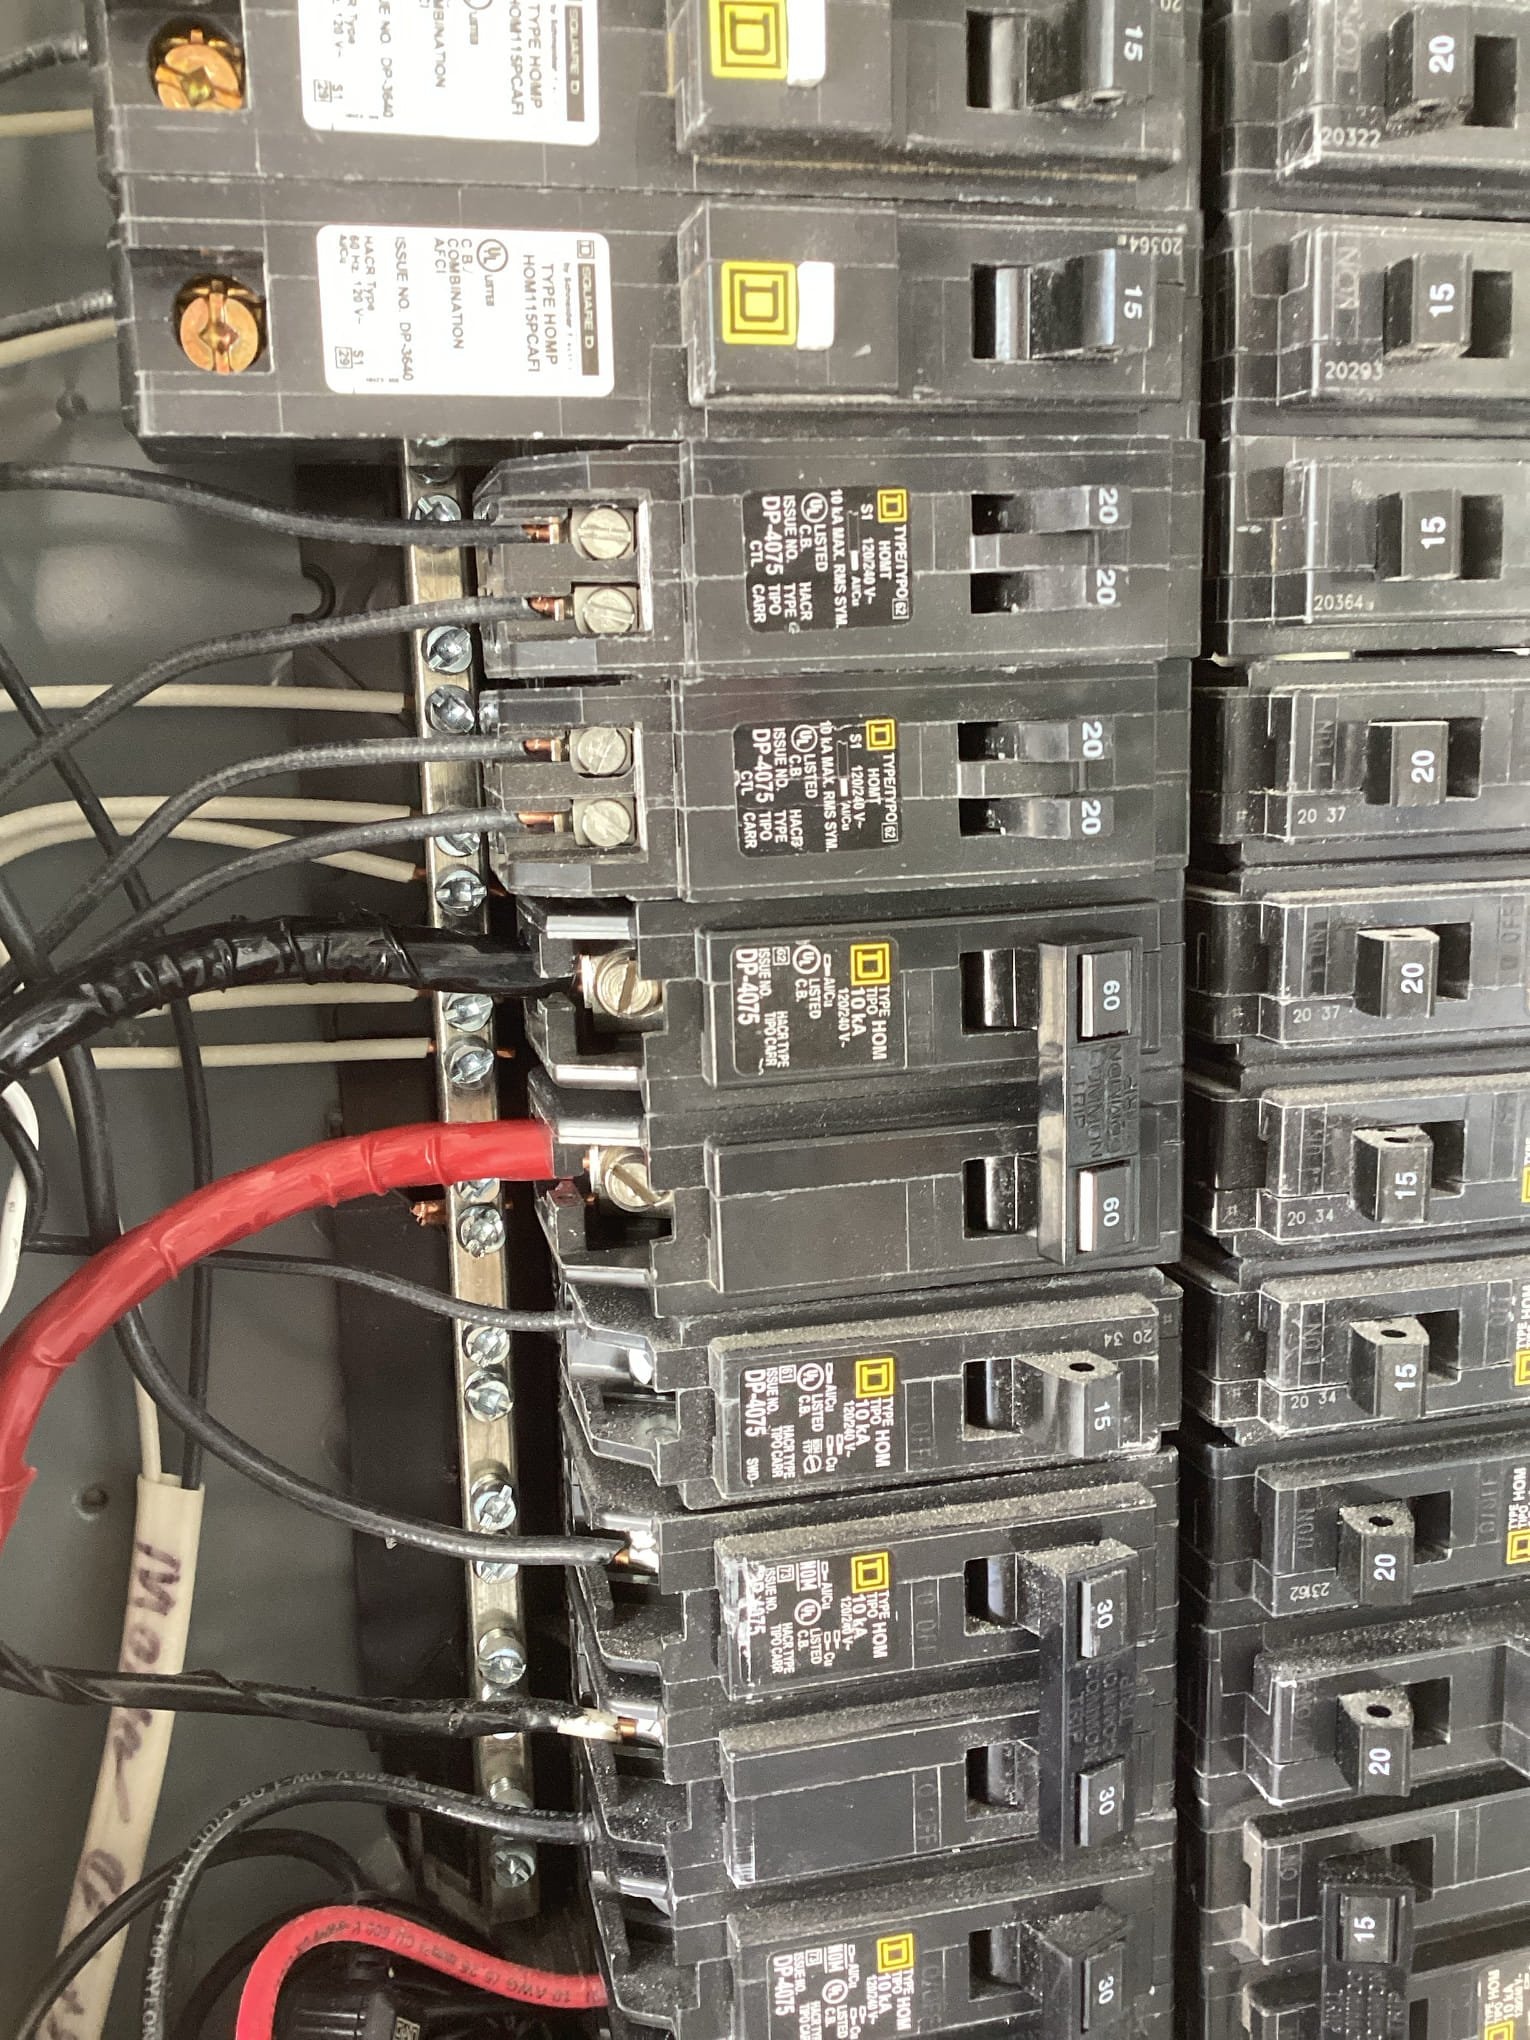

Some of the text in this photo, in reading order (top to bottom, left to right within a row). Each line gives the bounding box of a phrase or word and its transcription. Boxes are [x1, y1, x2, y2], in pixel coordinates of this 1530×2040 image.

[528, 4, 543, 109] TYPE HOMP
[1123, 25, 1143, 62] 15
[1429, 35, 1454, 73] 20
[1321, 126, 1381, 149] 20322
[350, 235, 363, 303] 60 120
[364, 236, 377, 311] HACR Type
[434, 238, 446, 274] AFCI
[395, 237, 414, 381] ISSUE DP-3640
[447, 238, 464, 349] COMBINATION
[582, 266, 594, 349] SQUARE D
[1123, 285, 1142, 319] 15
[1430, 283, 1454, 317] 15
[523, 255, 540, 372] HOM115PCAFI
[541, 264, 558, 365] TYPE HOMP
[339, 350, 349, 366] 29
[353, 350, 364, 365] S1
[1325, 360, 1383, 381] 20293
[1098, 487, 1118, 524] 20
[762, 496, 782, 575] DP-4075
[783, 495, 798, 563] ISSUE NO.
[799, 524, 812, 552] C.B.
[860, 503, 875, 585] S1 120/240
[1421, 517, 1445, 550] 15
[749, 540, 763, 568] CTL
[814, 524, 828, 572] LISTED
[830, 489, 847, 629] 10 kA MAX. RMS SYM.
[878, 540, 892, 580] HOMT
[752, 584, 766, 623] CARR
[768, 584, 781, 615] TIPO
[783, 583, 796, 618] TYPE
[799, 582, 812, 621] HACR
[1095, 569, 1116, 605] 20
[1313, 594, 1363, 611] 20364
[895, 602, 906, 615] 62
[1082, 720, 1102, 758] 20
[752, 728, 774, 803] DP-4075
[773, 728, 787, 791] ISSUE NO.
[804, 754, 818, 799] LISTED
[850, 734, 864, 810] S1 120/240
[1410, 749, 1435, 784] 20
[741, 770, 754, 796] CTL
[820, 720, 838, 852] 10 kA MAX. RMS SYM.
[867, 767, 881, 805] HOMT
[743, 812, 757, 849] CARR
[760, 811, 772, 841] TIPO
[774, 810, 787, 843] TYPE
[885, 826, 896, 838] 62
[1081, 800, 1101, 835] 20
[1297, 806, 1346, 825] 20 37
[736, 948, 760, 1025] DP-4075
[758, 947, 772, 1000] ISSUE NO.
[795, 978, 808, 1002] C.B.
[1401, 962, 1424, 994] 20
[809, 978, 821, 1019] LISTED
[837, 987, 850, 1030] 120/240
[851, 987, 866, 1036] 10 kA
[866, 986, 878, 1014] TIPO
[1103, 980, 1120, 1011] 60
[1293, 1005, 1340, 1023] 20 37
[764, 1012, 777, 1066] TIPO CARR
[776, 1011, 789, 1068] HACR TYPE
[871, 986, 891, 1060] TYPE HOM
[1394, 1171, 1417, 1199] 15
[1102, 1197, 1119, 1227] 60
[1287, 1210, 1334, 1226] 20 34
[1103, 1328, 1153, 1347] 20 34
[1516, 1321, 1527, 1349] TYPE
[765, 1367, 779, 1415] ISSUE NO.
[1394, 1364, 1416, 1391] 15
[745, 1369, 766, 1437] DP-4075
[798, 1395, 810, 1417] C.B.
[811, 1393, 824, 1432] LISTED
[870, 1397, 881, 1425] TIPO
[1093, 1401, 1110, 1431] 15
[1291, 1391, 1336, 1408] 20 34
[843, 1400, 855, 1441] 120/240
[855, 1398, 870, 1446] 10 kA
[874, 1396, 894, 1467] TYPE HOM
[771, 1426, 783, 1478] TIPO CARR
[783, 1424, 795, 1478] HACR TYPE
[825, 1456, 837, 1472] Cu
[1508, 1467, 1526, 1530] TYPE HOM
[1374, 1554, 1396, 1582] 20
[764, 1567, 777, 1614] ISSUE NO.
[867, 1592, 878, 1618] TIPO
[1288, 1582, 1330, 1602] 23162
[840, 1595, 853, 1635] 120/240
[852, 1593, 867, 1639] 10 kA
[872, 1590, 890, 1658] TYPE HOM
[1096, 1599, 1113, 1629] 30
[770, 1623, 783, 1674] TIPO CARR
[781, 1622, 795, 1674] HACR TYPE
[797, 1629, 809, 1651] C.B.
[810, 1628, 822, 1664] LISTED
[823, 1652, 835, 1667] Cu
[1369, 1748, 1390, 1775] 20
[1098, 1786, 1115, 1816] 30
[1353, 1916, 1375, 1944] 15
[141, 1861, 188, 2040] TYPE T90 NYLON
[773, 1954, 795, 2016] DP-4075
[877, 1973, 892, 2014] 10 kA
[896, 1968, 914, 2031] TYPE HOM
[1098, 1975, 1114, 2005] 30
[836, 2004, 848, 2038] LISTED
